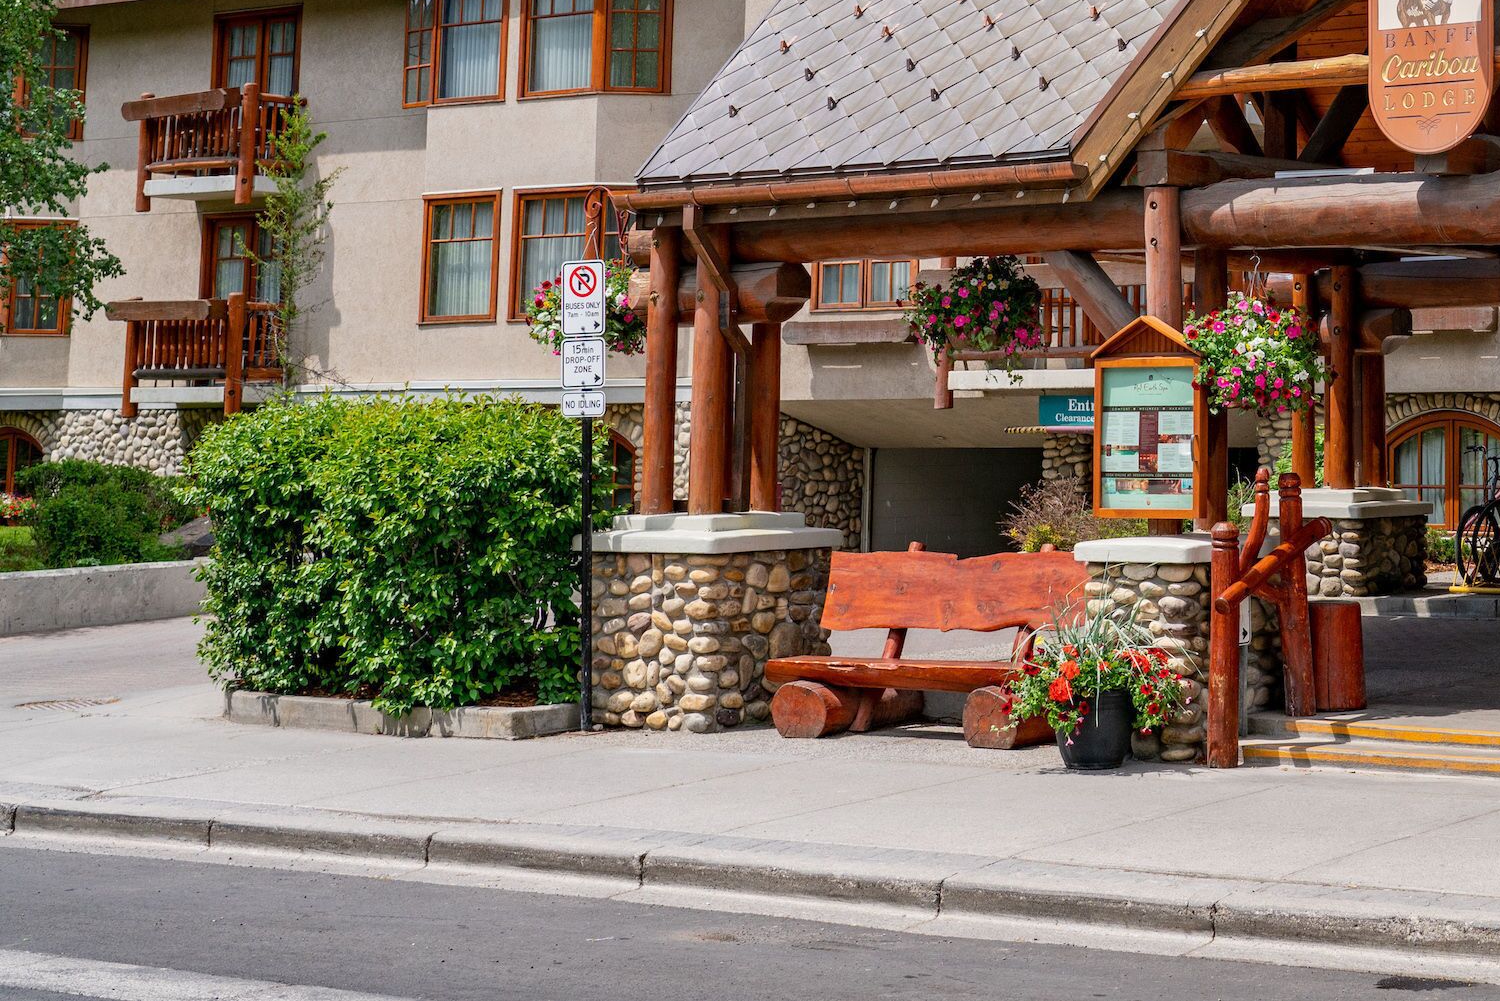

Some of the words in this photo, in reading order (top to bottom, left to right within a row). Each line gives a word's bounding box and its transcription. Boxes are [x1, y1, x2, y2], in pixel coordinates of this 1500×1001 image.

[1385, 26, 1476, 49] BANFF
[1381, 51, 1480, 84] Caribou
[1383, 88, 1476, 111] LODGE
[565, 302, 585, 310] BUSES
[586, 301, 601, 309] ONLY
[574, 365, 593, 374] ZONE
[565, 400, 576, 409] NO
[578, 399, 601, 409] IDLING
[1055, 412, 1095, 423] Clearance
